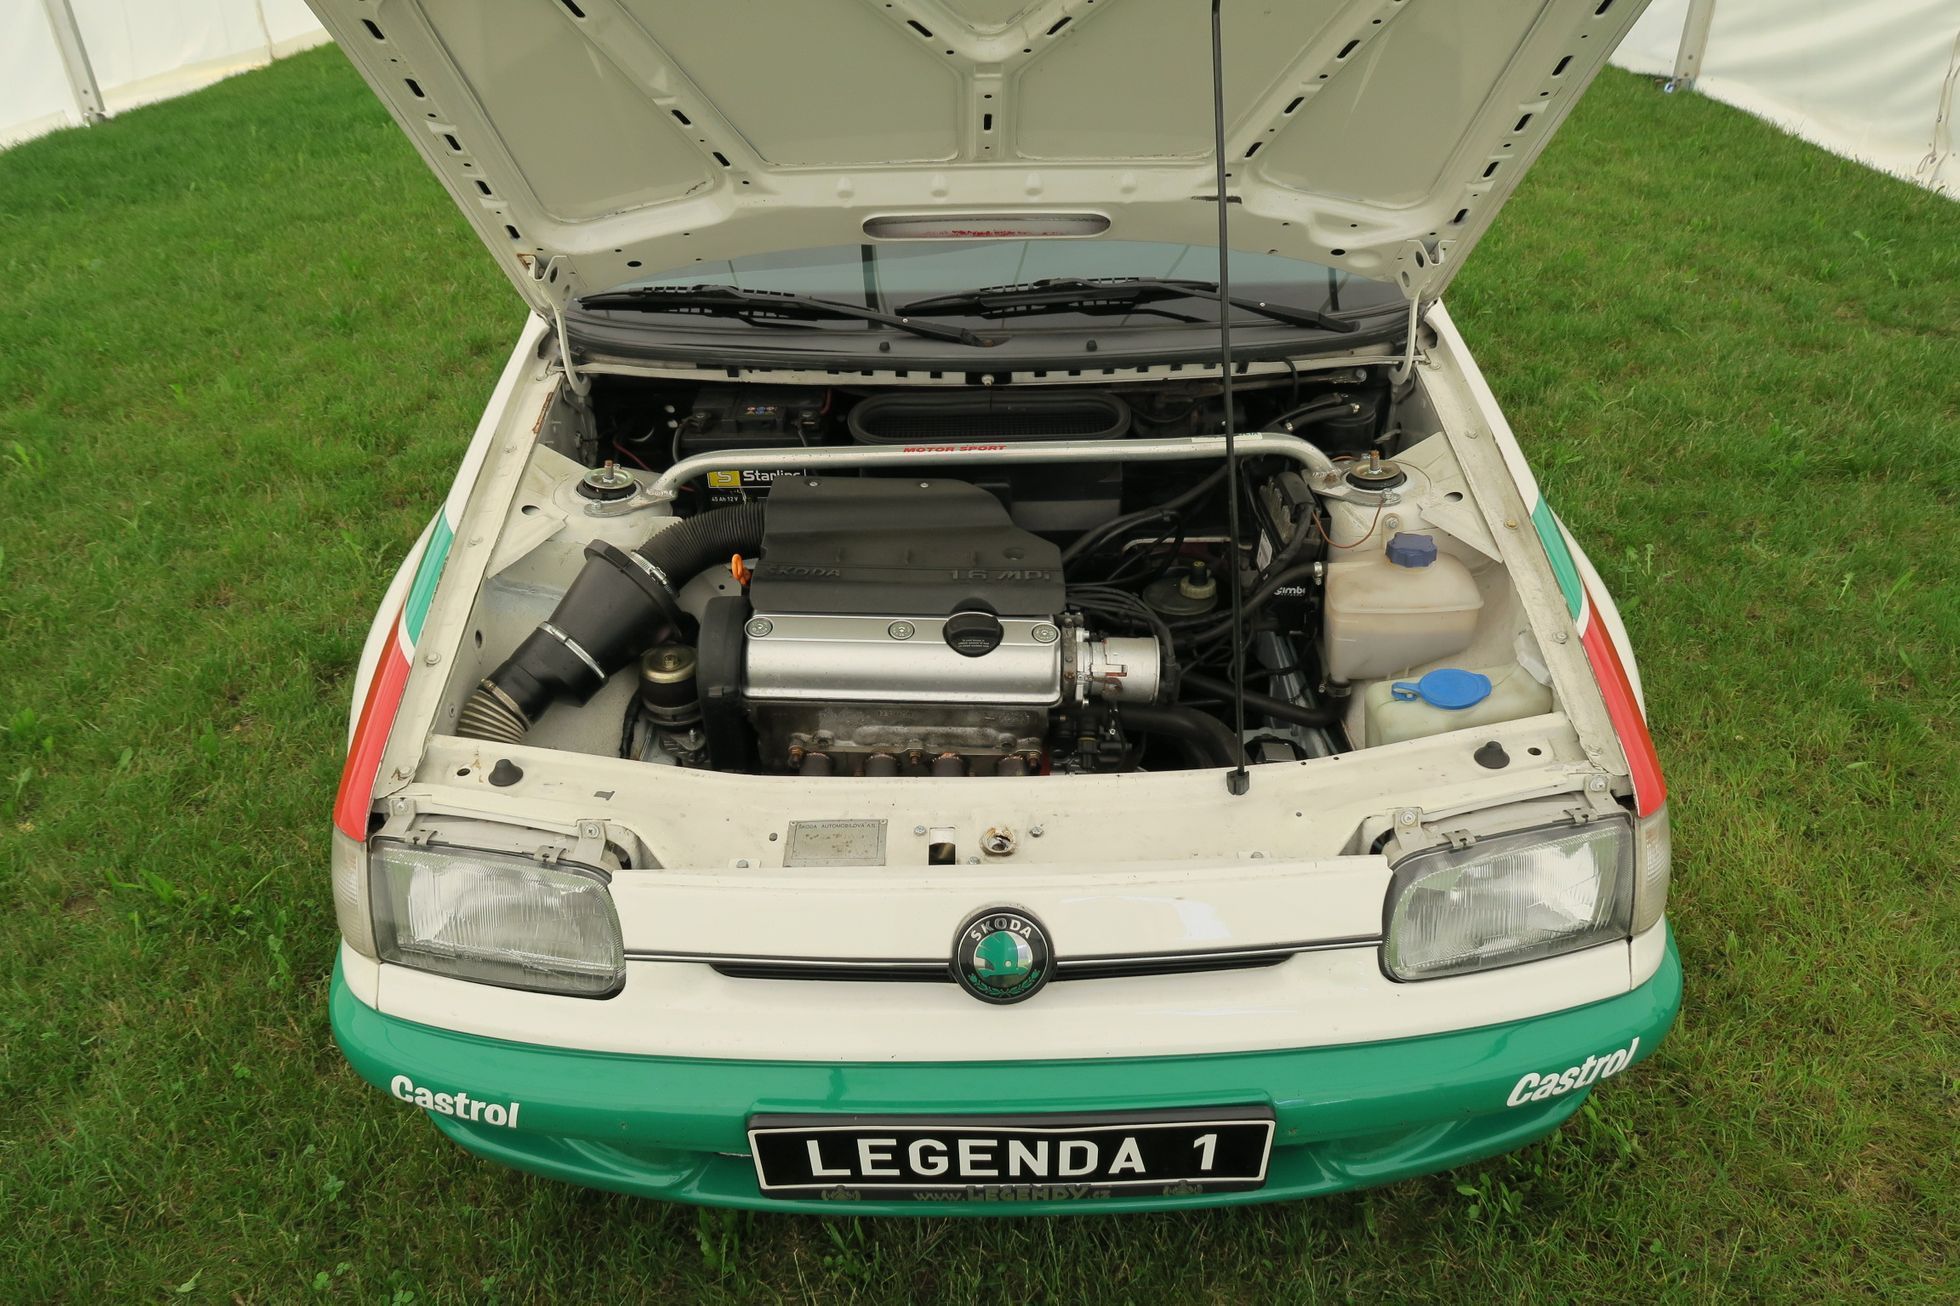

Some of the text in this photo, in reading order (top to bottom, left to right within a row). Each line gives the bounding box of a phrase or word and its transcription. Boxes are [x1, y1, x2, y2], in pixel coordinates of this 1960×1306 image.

[1506, 1036, 1640, 1107] Castrol
[390, 1074, 520, 1128] Castrol
[806, 1133, 1218, 1176] LEGENDA 1
